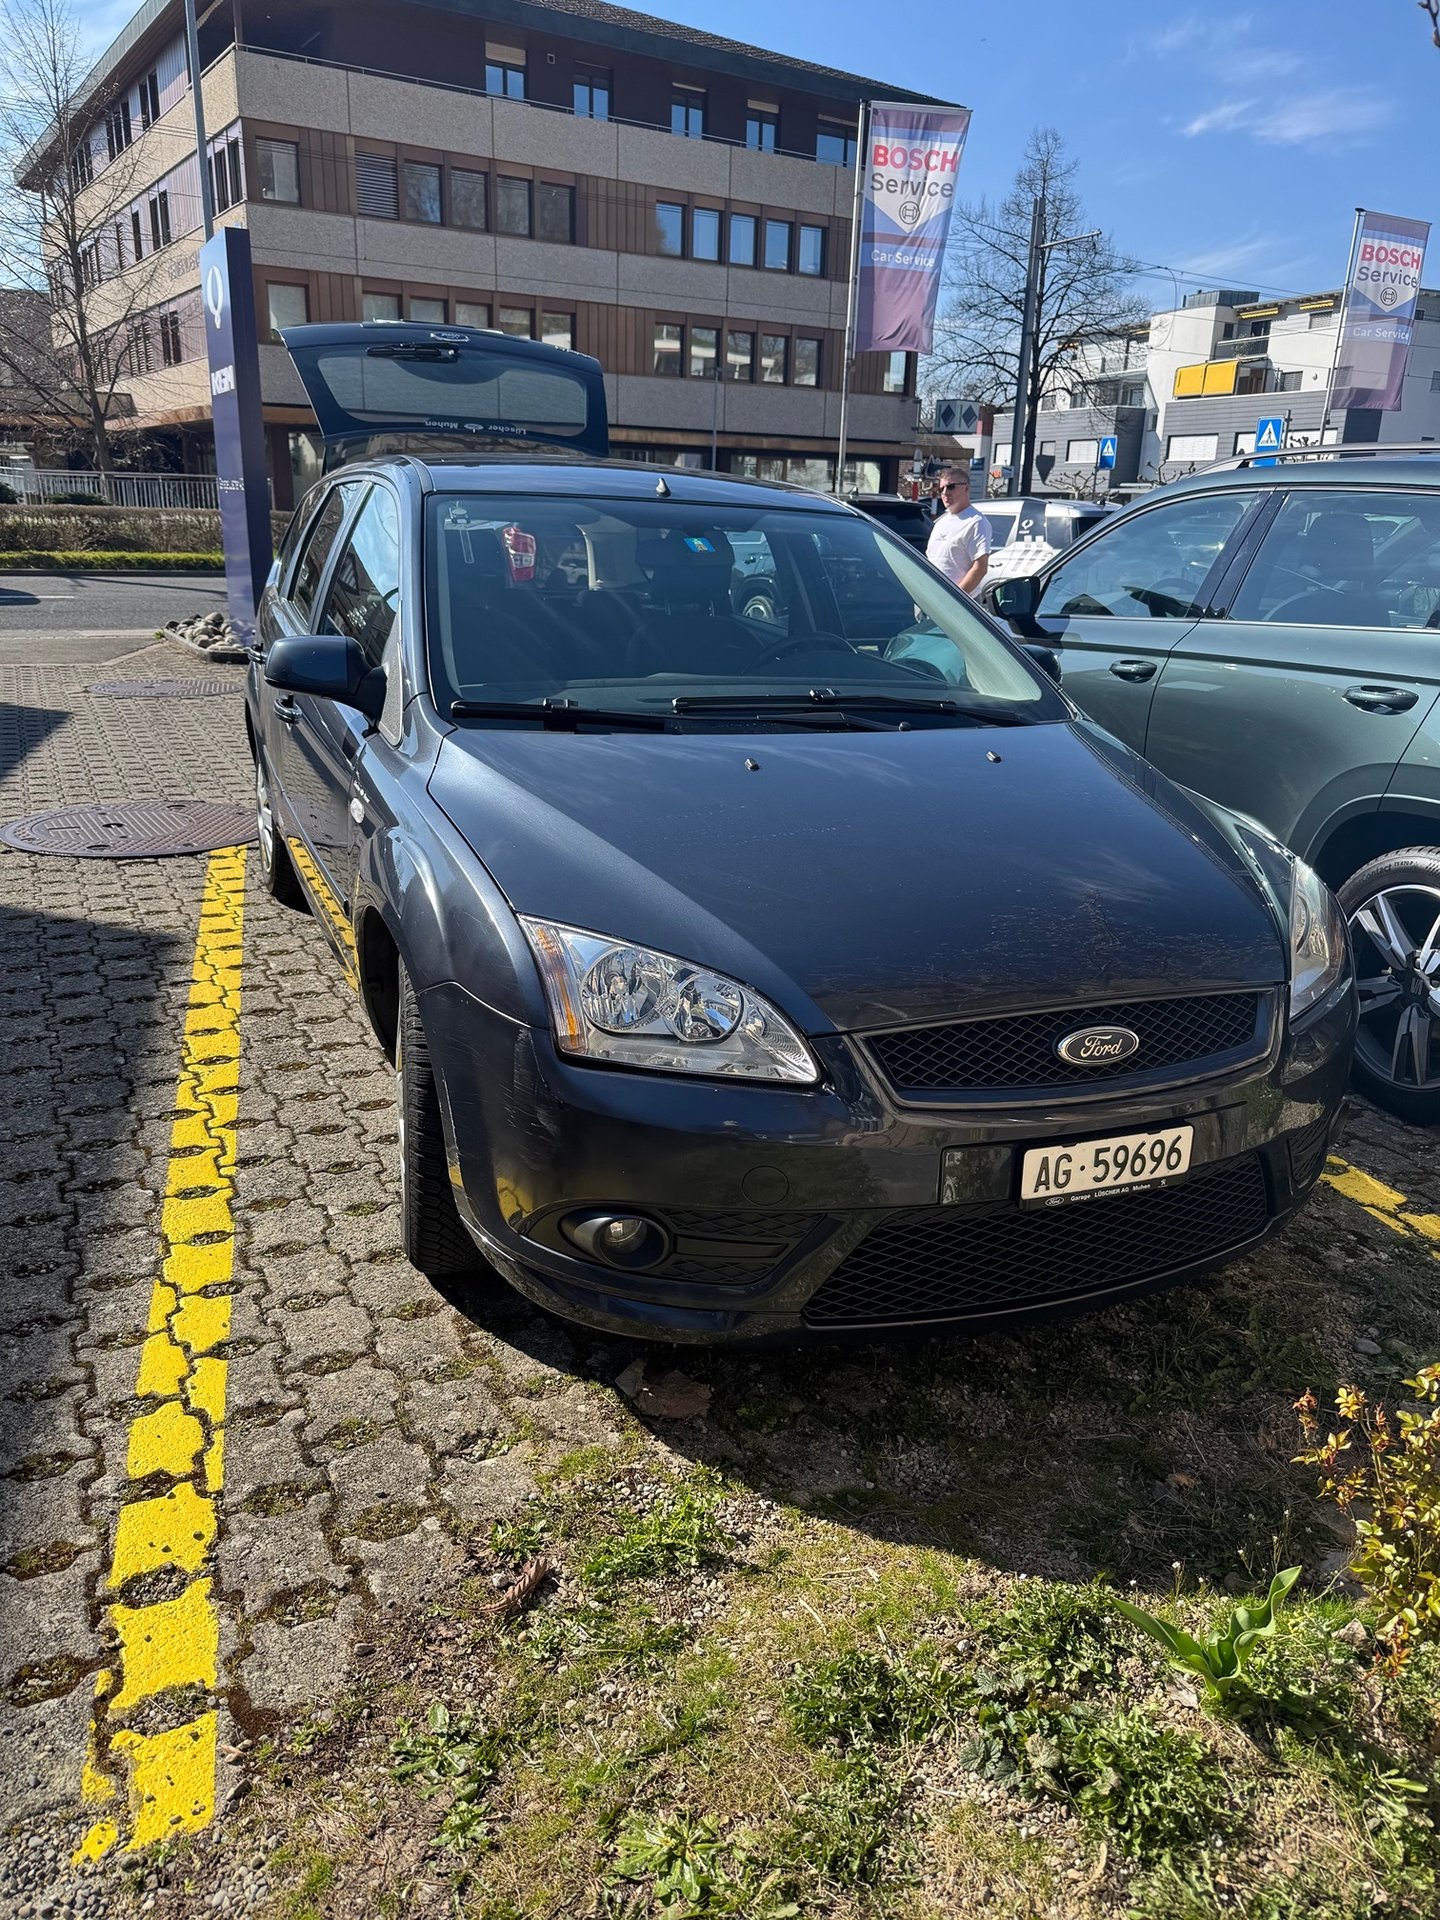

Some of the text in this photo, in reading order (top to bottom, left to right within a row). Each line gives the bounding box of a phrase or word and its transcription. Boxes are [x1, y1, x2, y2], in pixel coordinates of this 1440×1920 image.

[873, 144, 958, 173] BOSCH
[870, 172, 954, 198] Service
[871, 249, 936, 267] Car Service
[1361, 244, 1421, 270] BOSCH
[1357, 266, 1418, 289] Service
[1353, 327, 1410, 340] Car Service
[425, 420, 459, 429] Muhen
[487, 424, 527, 435] Lüscher
[1080, 1034, 1123, 1058] Ford
[1070, 1194, 1091, 1202] Garage
[1094, 1188, 1121, 1198] LÜSCHER
[1132, 1183, 1151, 1191] Muhen
